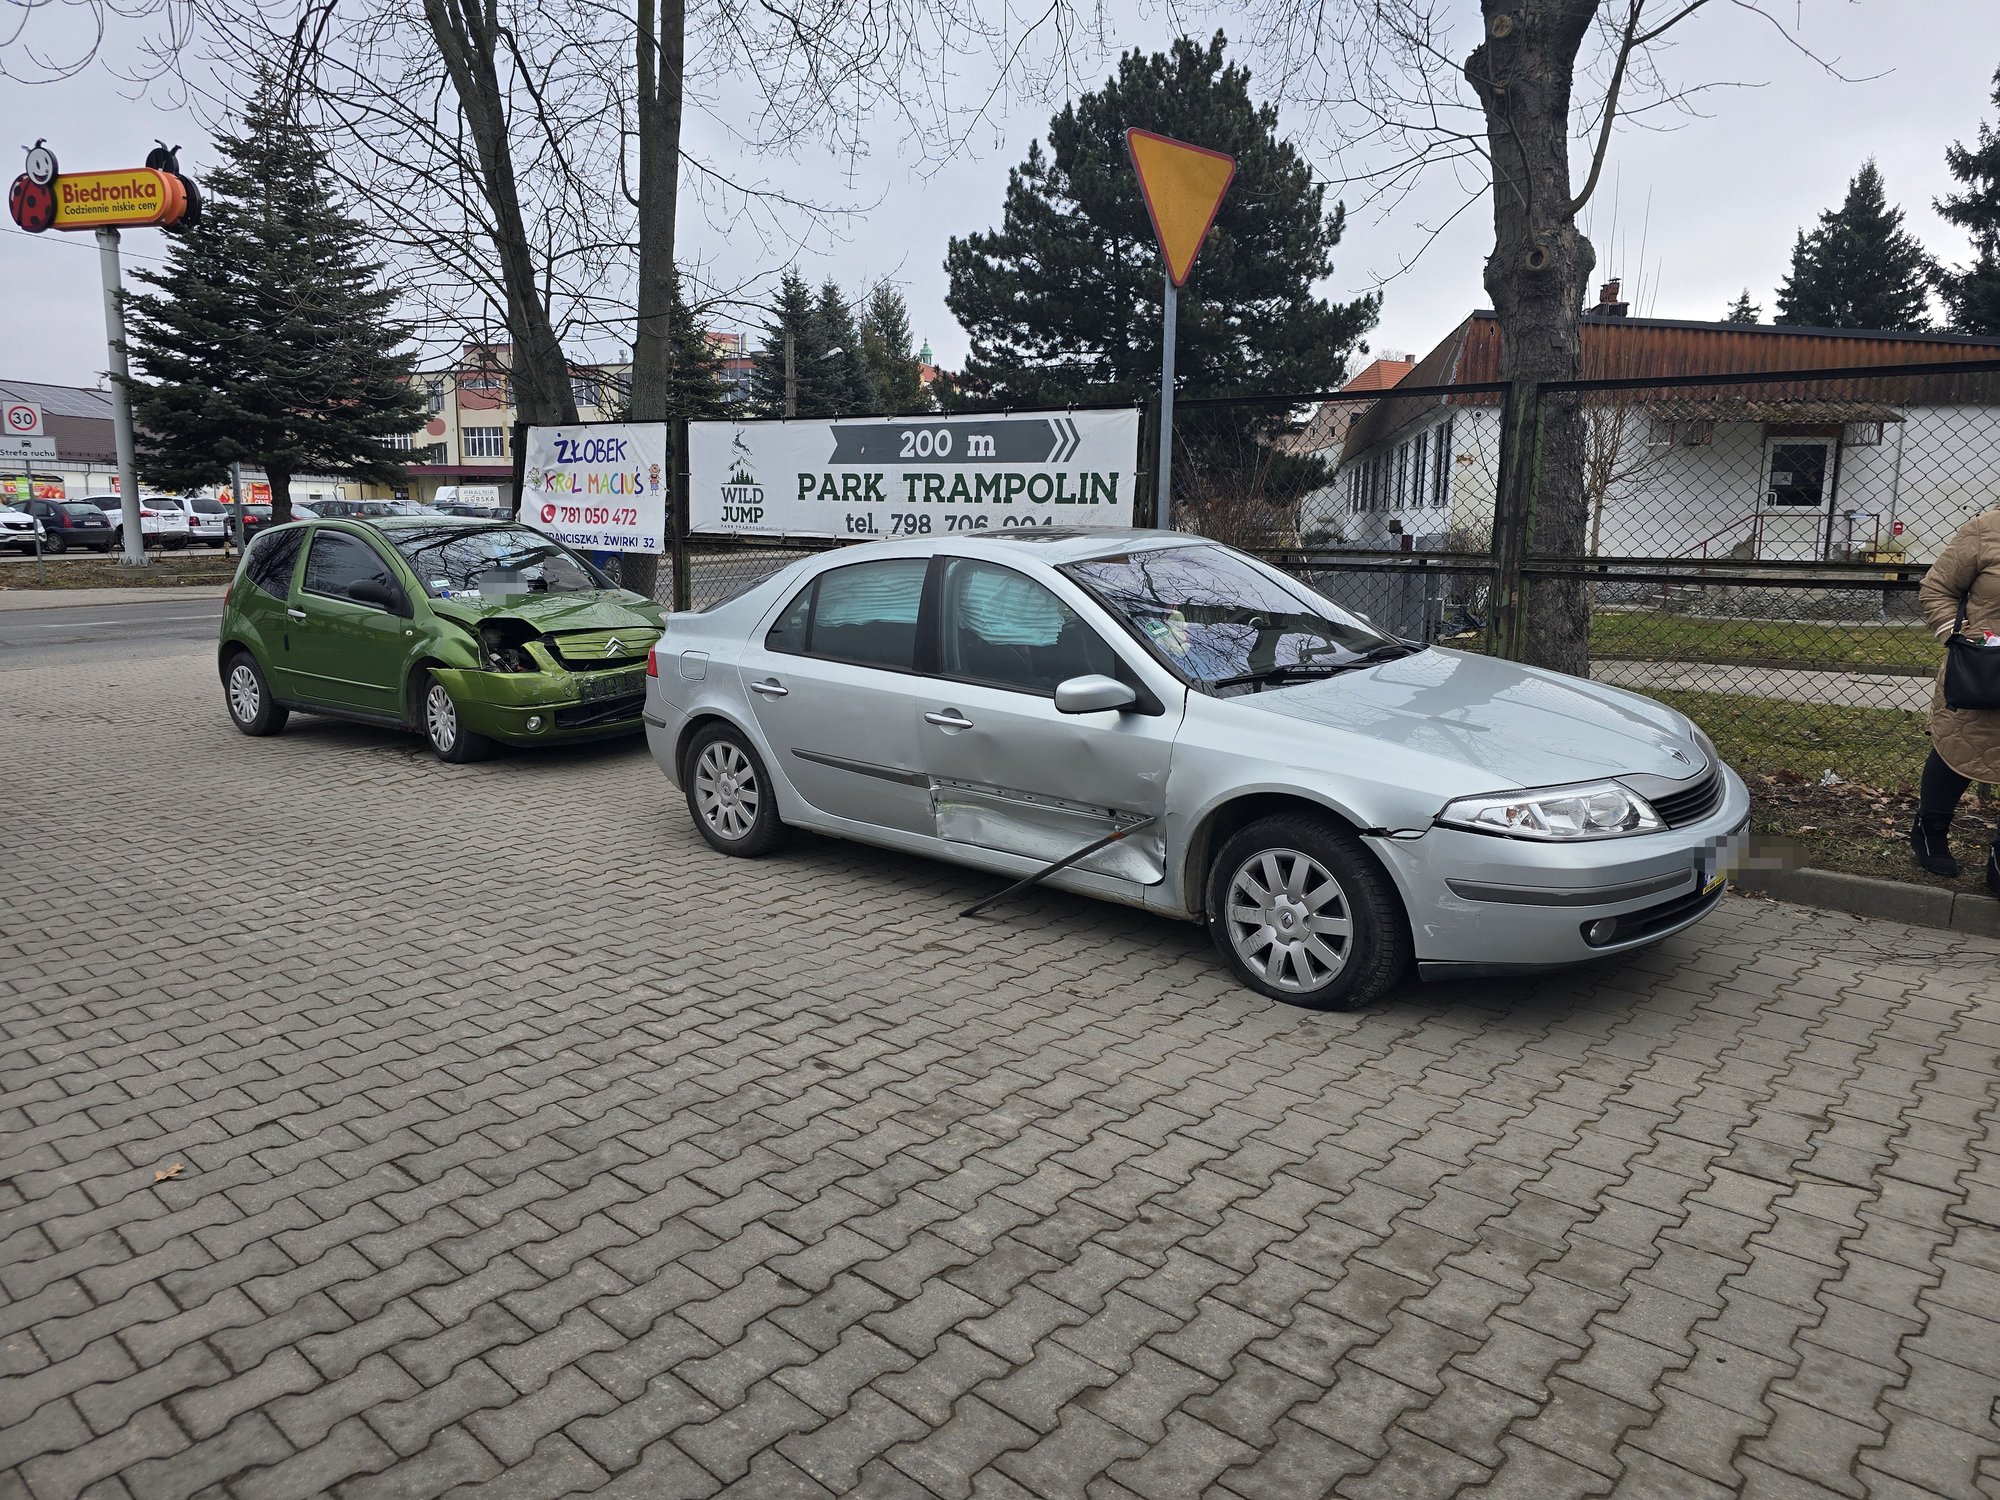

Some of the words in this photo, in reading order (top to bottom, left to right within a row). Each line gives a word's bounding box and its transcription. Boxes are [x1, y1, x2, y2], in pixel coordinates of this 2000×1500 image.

[62, 179, 157, 204] Biedronka
[64, 204, 110, 216] Codziennie
[112, 201, 136, 212] niskie
[138, 202, 158, 212] ceny
[13, 412, 33, 425] 30
[0, 449, 28, 457] Strefa
[31, 449, 56, 457] ruchu
[553, 432, 628, 464] ŻŁOBEK
[899, 429, 953, 458] 200
[967, 435, 996, 457] m
[544, 471, 582, 494] KRÓL
[588, 466, 644, 495] MACIUŚ
[797, 473, 886, 502] PARK
[902, 472, 1120, 505] TRAMPOLIN
[720, 486, 765, 505] WILD
[560, 506, 581, 524] 781
[584, 507, 609, 525] 050
[612, 508, 637, 526] 472
[720, 505, 765, 524] JUMP
[845, 512, 879, 534] tel.
[891, 513, 932, 535] 798
[544, 531, 599, 545] ANCISZKA
[603, 533, 638, 547] ŻWIRKI
[643, 537, 655, 548] 32
